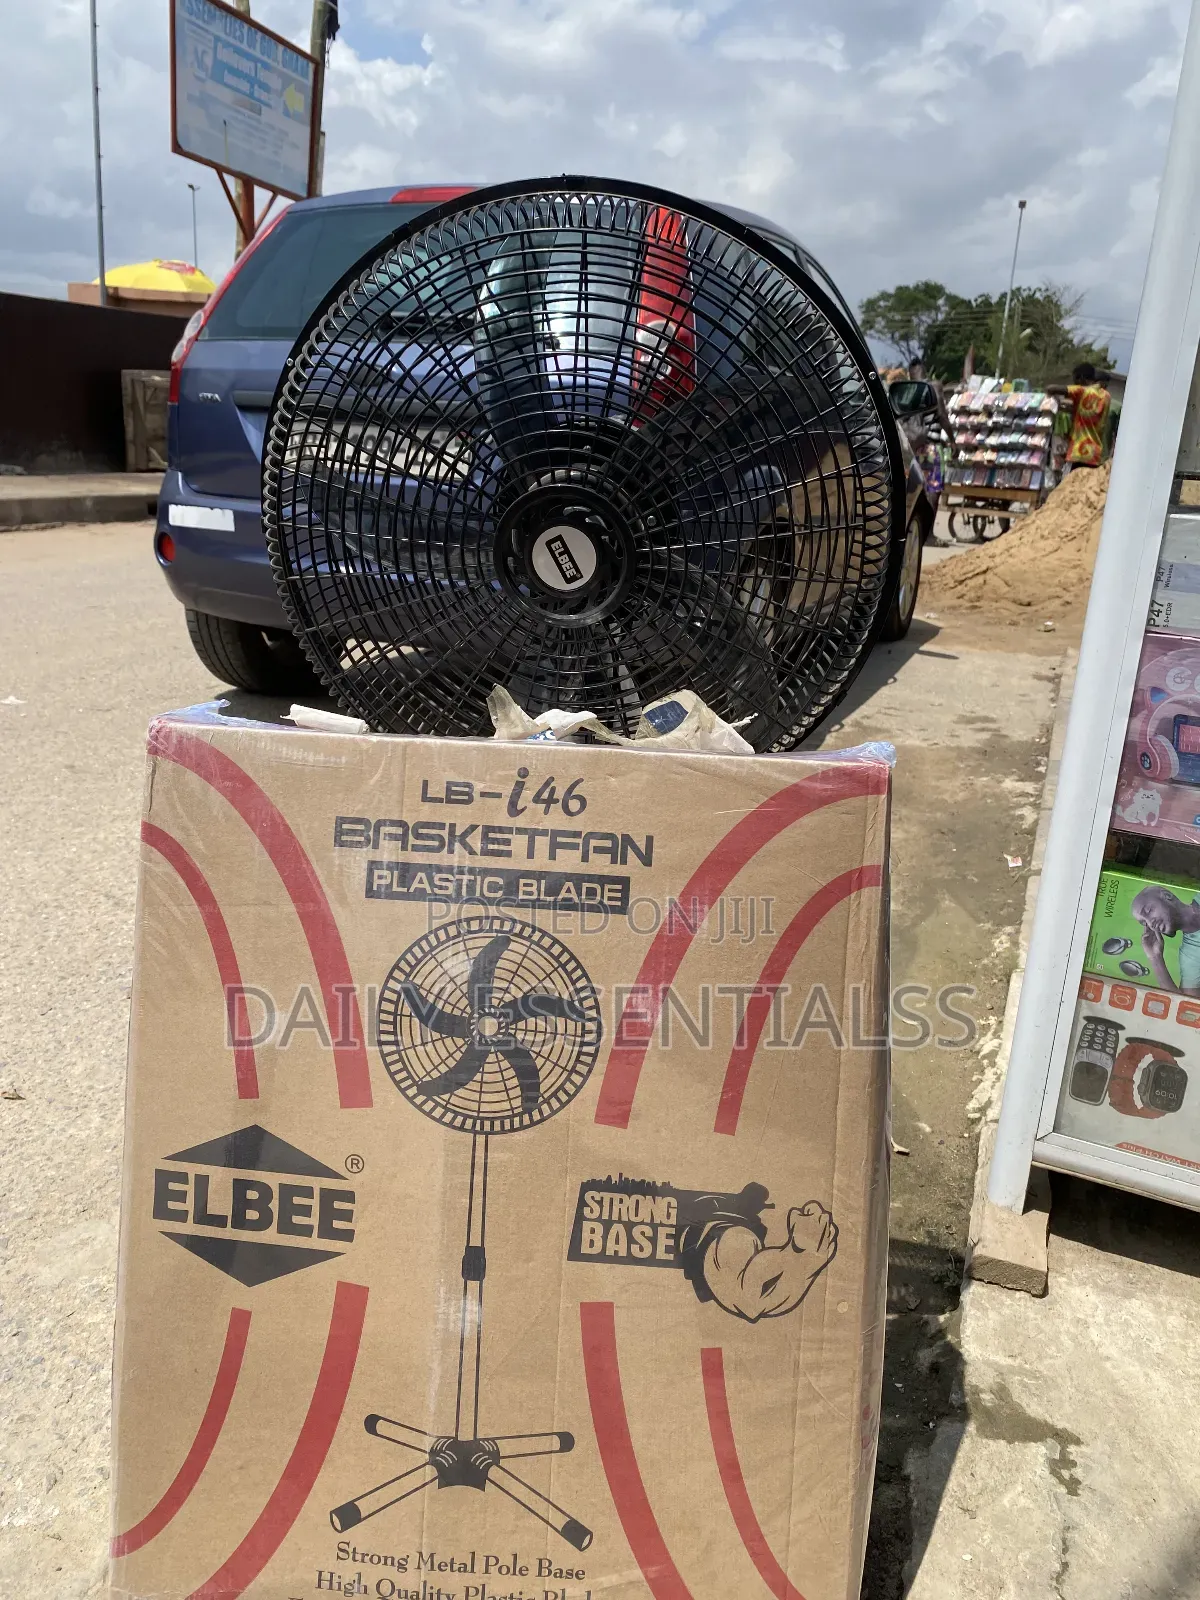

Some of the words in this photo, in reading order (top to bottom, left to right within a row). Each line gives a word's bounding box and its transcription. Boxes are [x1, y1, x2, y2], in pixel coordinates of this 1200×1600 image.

[550, 540, 577, 579] ELBEE
[1155, 566, 1166, 583] P47
[1146, 599, 1164, 628] P47
[333, 815, 655, 868] BASKETFAN
[372, 870, 505, 899] PLASTIC
[518, 879, 623, 907] BLADE
[1104, 879, 1120, 918] WIRELESS
[152, 1168, 356, 1243] ELBEE
[583, 1190, 678, 1225] STRONG
[581, 1220, 676, 1261] BASE
[336, 1541, 409, 1573] Strong
[415, 1551, 476, 1575] Metal
[482, 1553, 529, 1576] Pole
[535, 1557, 586, 1580] Base
[314, 1570, 369, 1597] High
